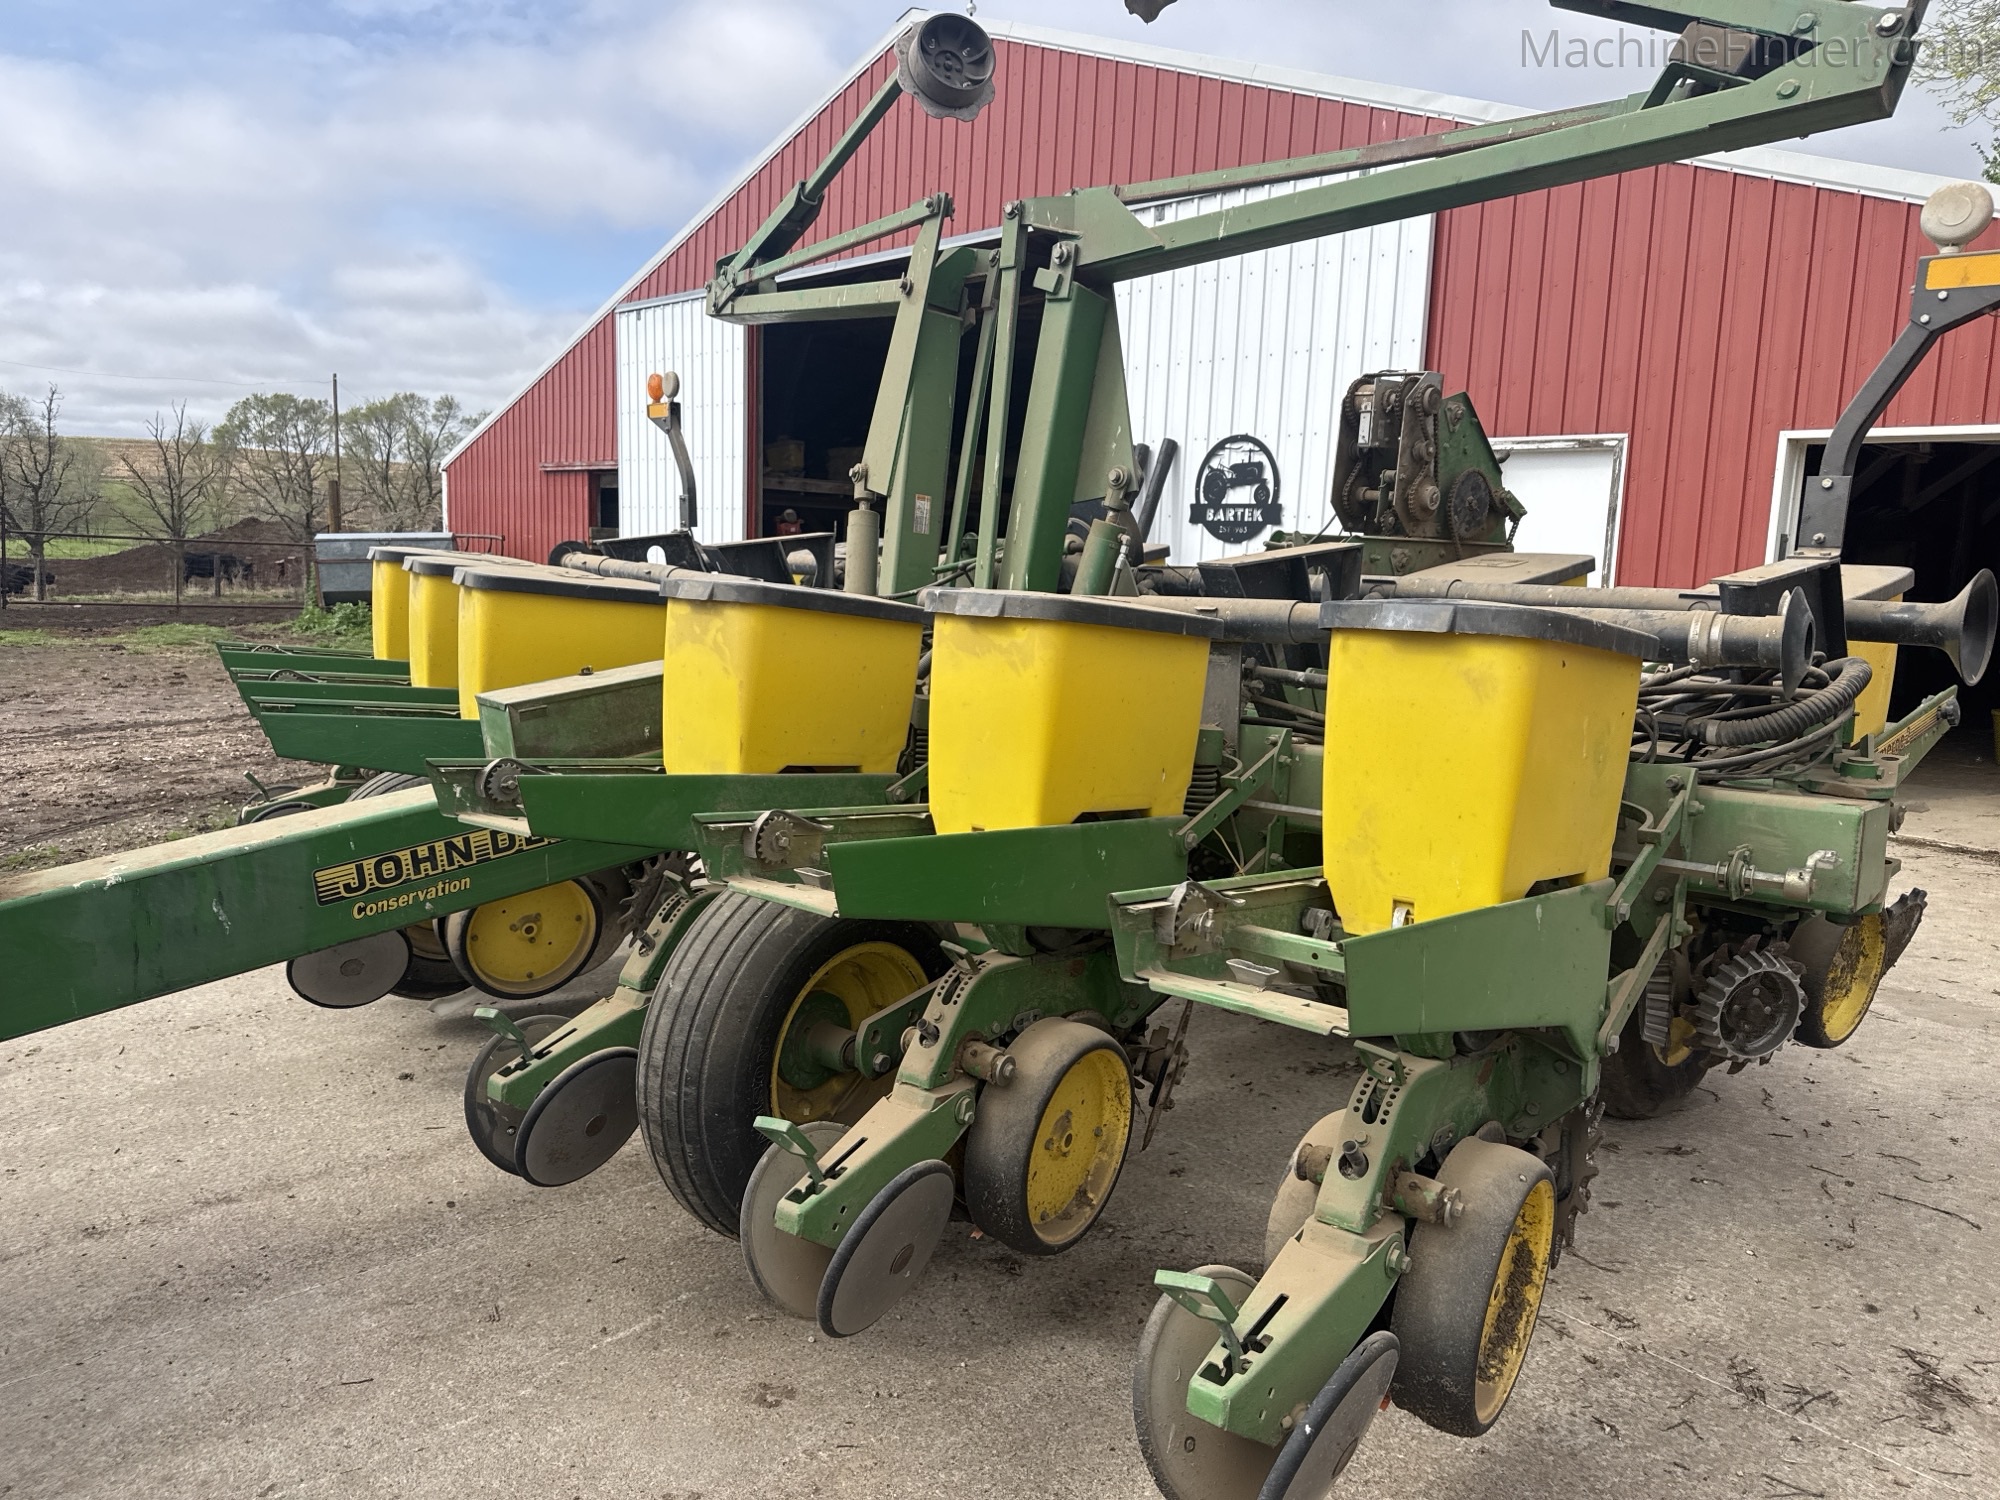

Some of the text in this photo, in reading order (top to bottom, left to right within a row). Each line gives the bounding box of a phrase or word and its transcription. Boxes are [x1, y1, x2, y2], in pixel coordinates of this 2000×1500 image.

[1205, 508, 1264, 522] BARTEK
[339, 834, 478, 898] JOHN
[352, 876, 471, 920] Conservation
